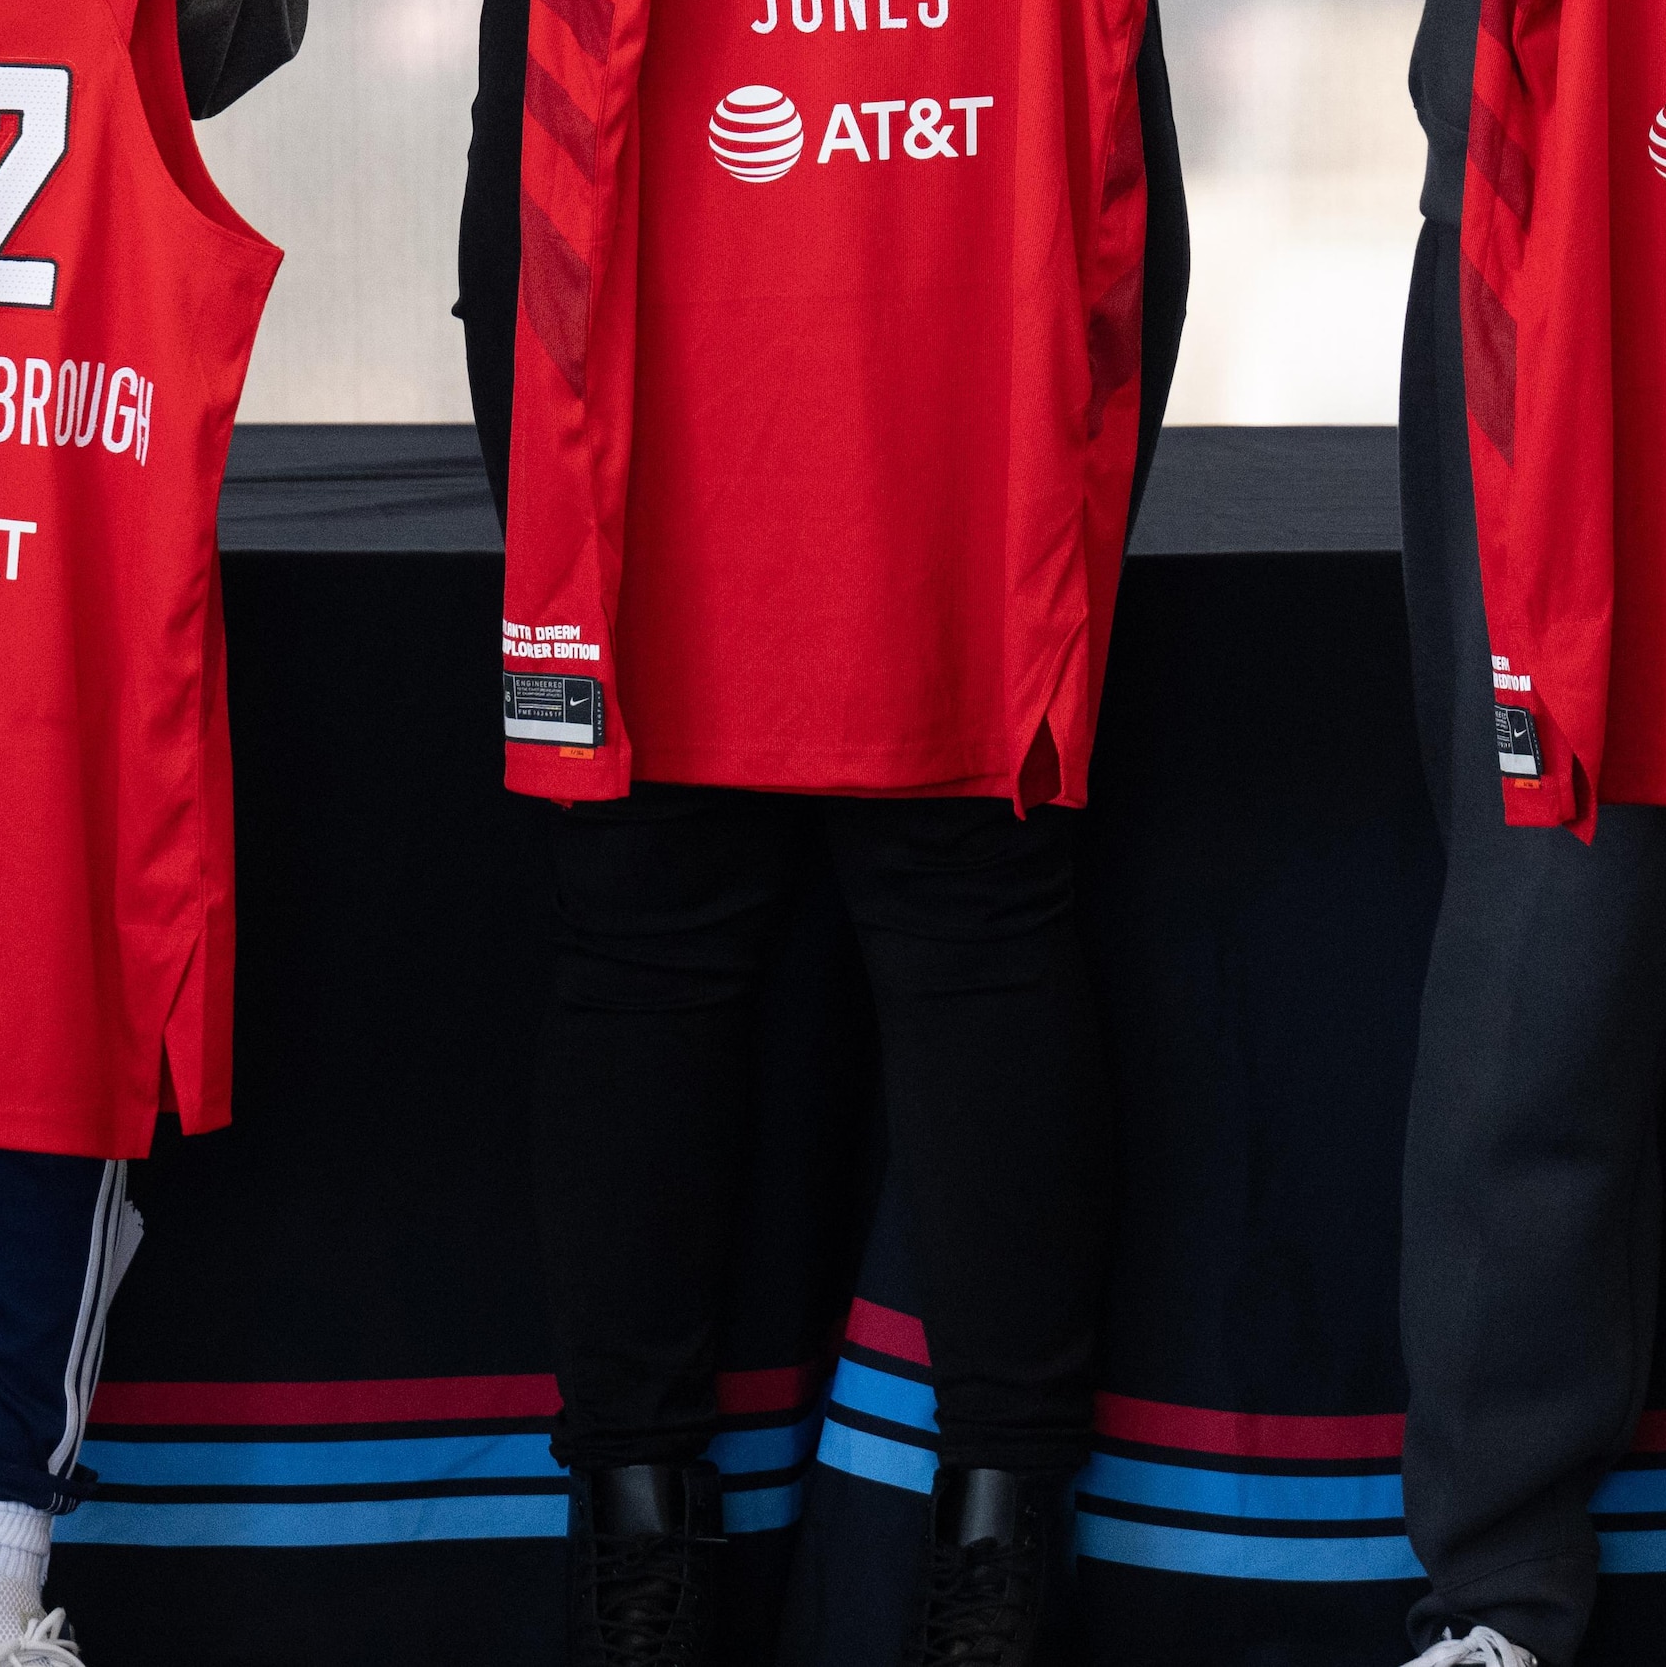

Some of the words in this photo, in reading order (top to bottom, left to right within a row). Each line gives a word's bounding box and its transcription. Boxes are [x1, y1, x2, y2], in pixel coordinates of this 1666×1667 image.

[817, 95, 994, 165] AT&T
[535, 626, 580, 640] DREAM
[554, 643, 599, 660] EDITION
